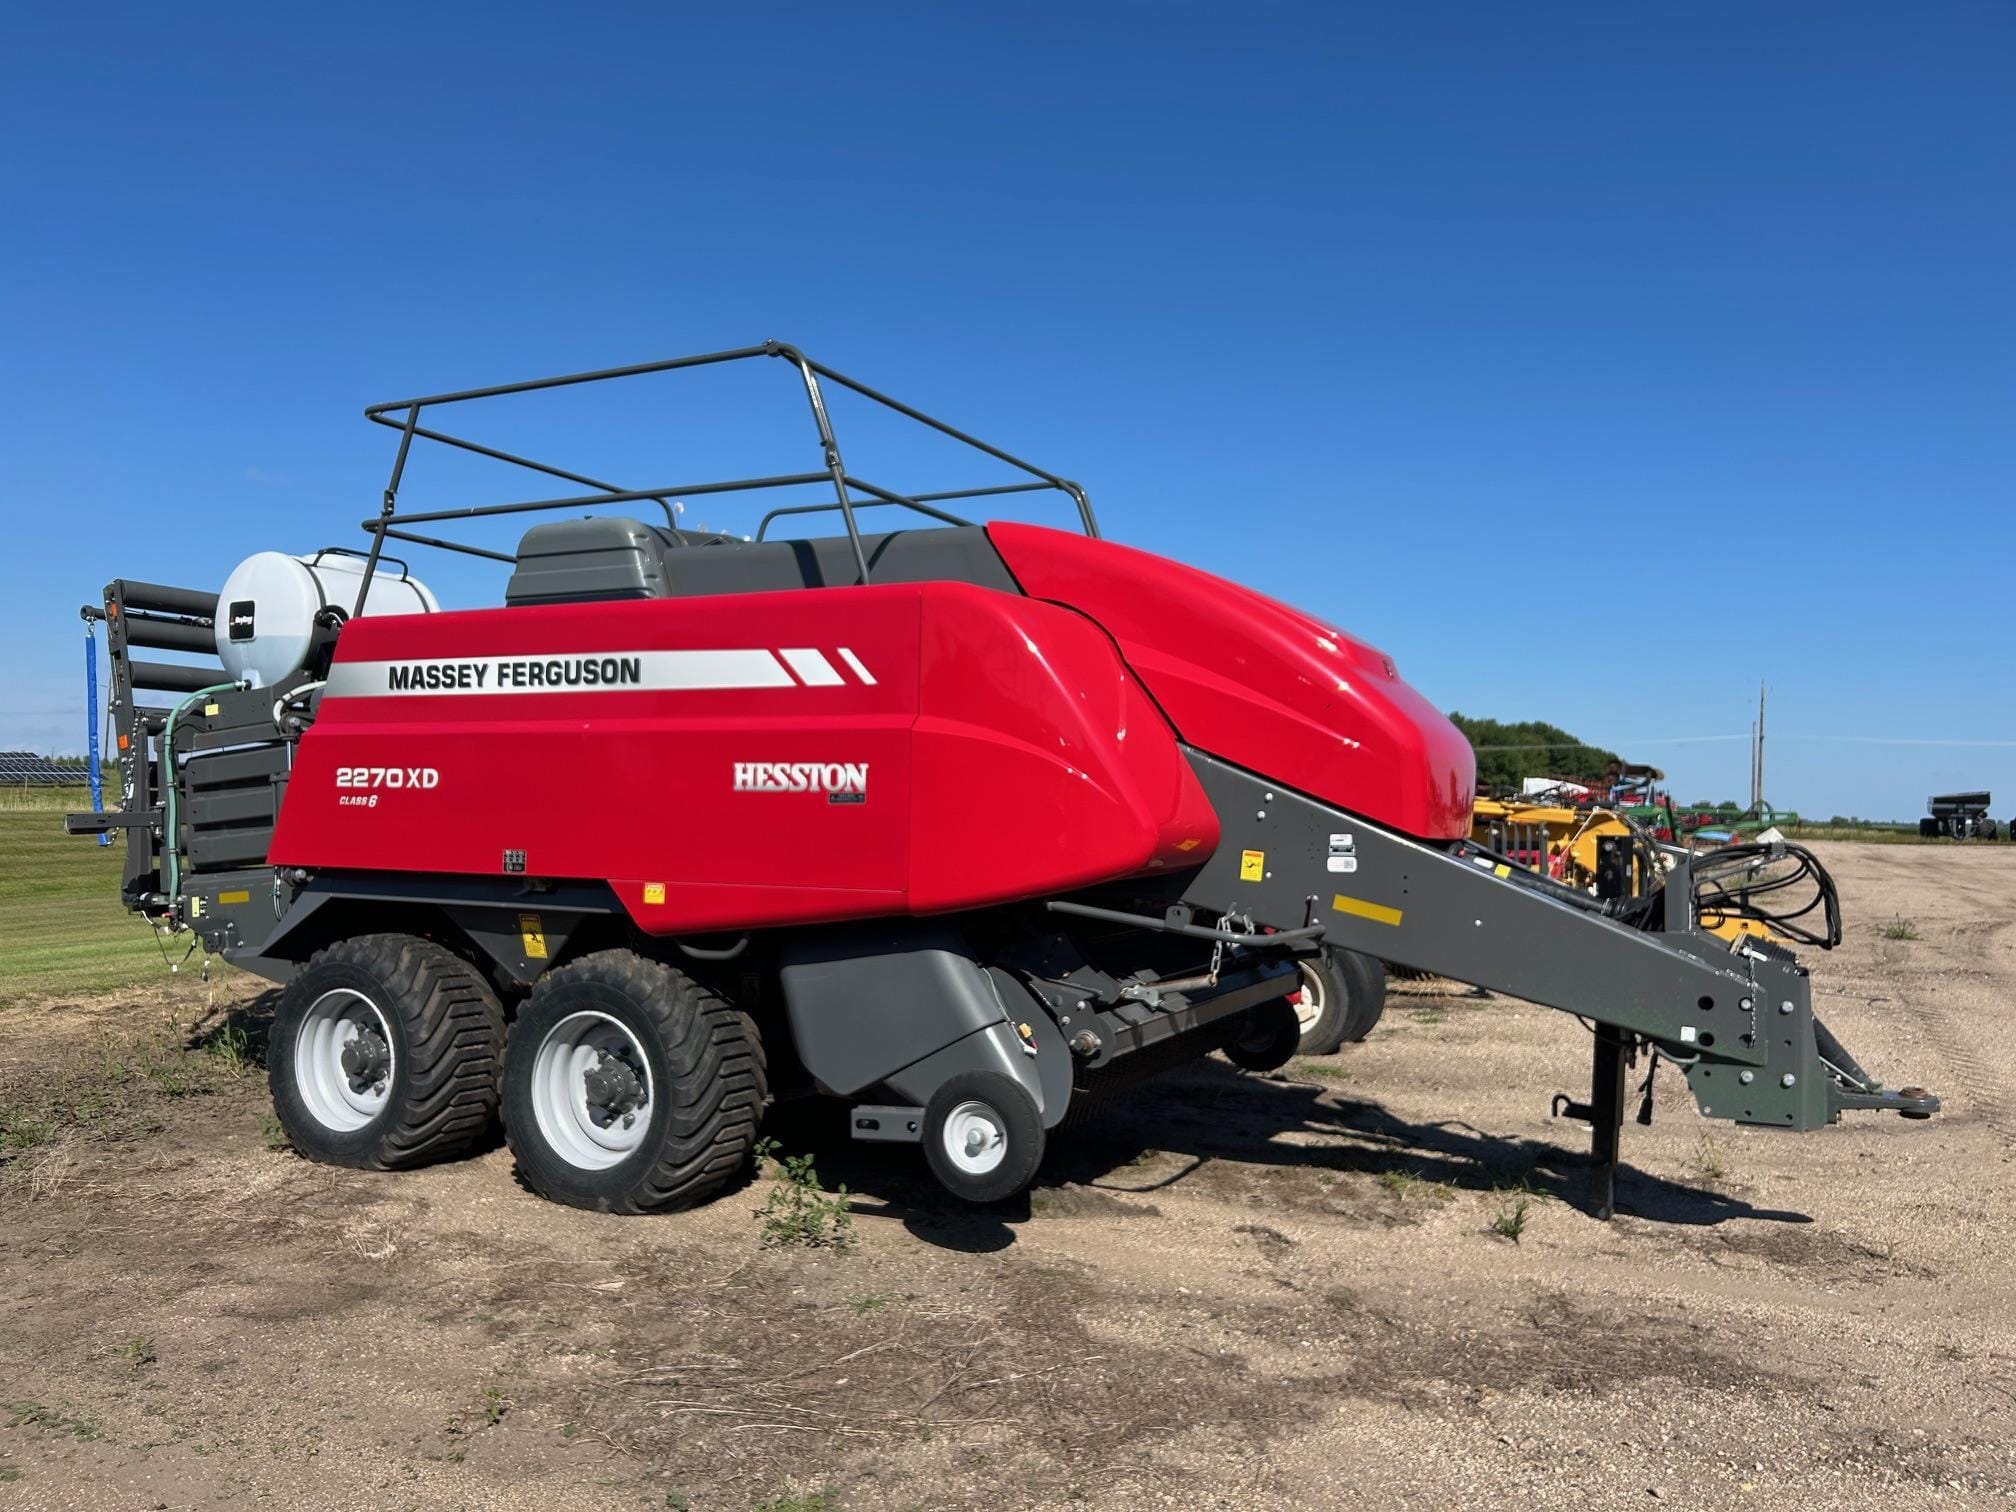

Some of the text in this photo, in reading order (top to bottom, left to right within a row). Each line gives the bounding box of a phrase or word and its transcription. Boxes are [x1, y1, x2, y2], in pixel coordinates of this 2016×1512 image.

[389, 658, 641, 690] MASSEY FERGUSON
[336, 767, 439, 789] 2270XD
[733, 762, 869, 792] HESSTON
